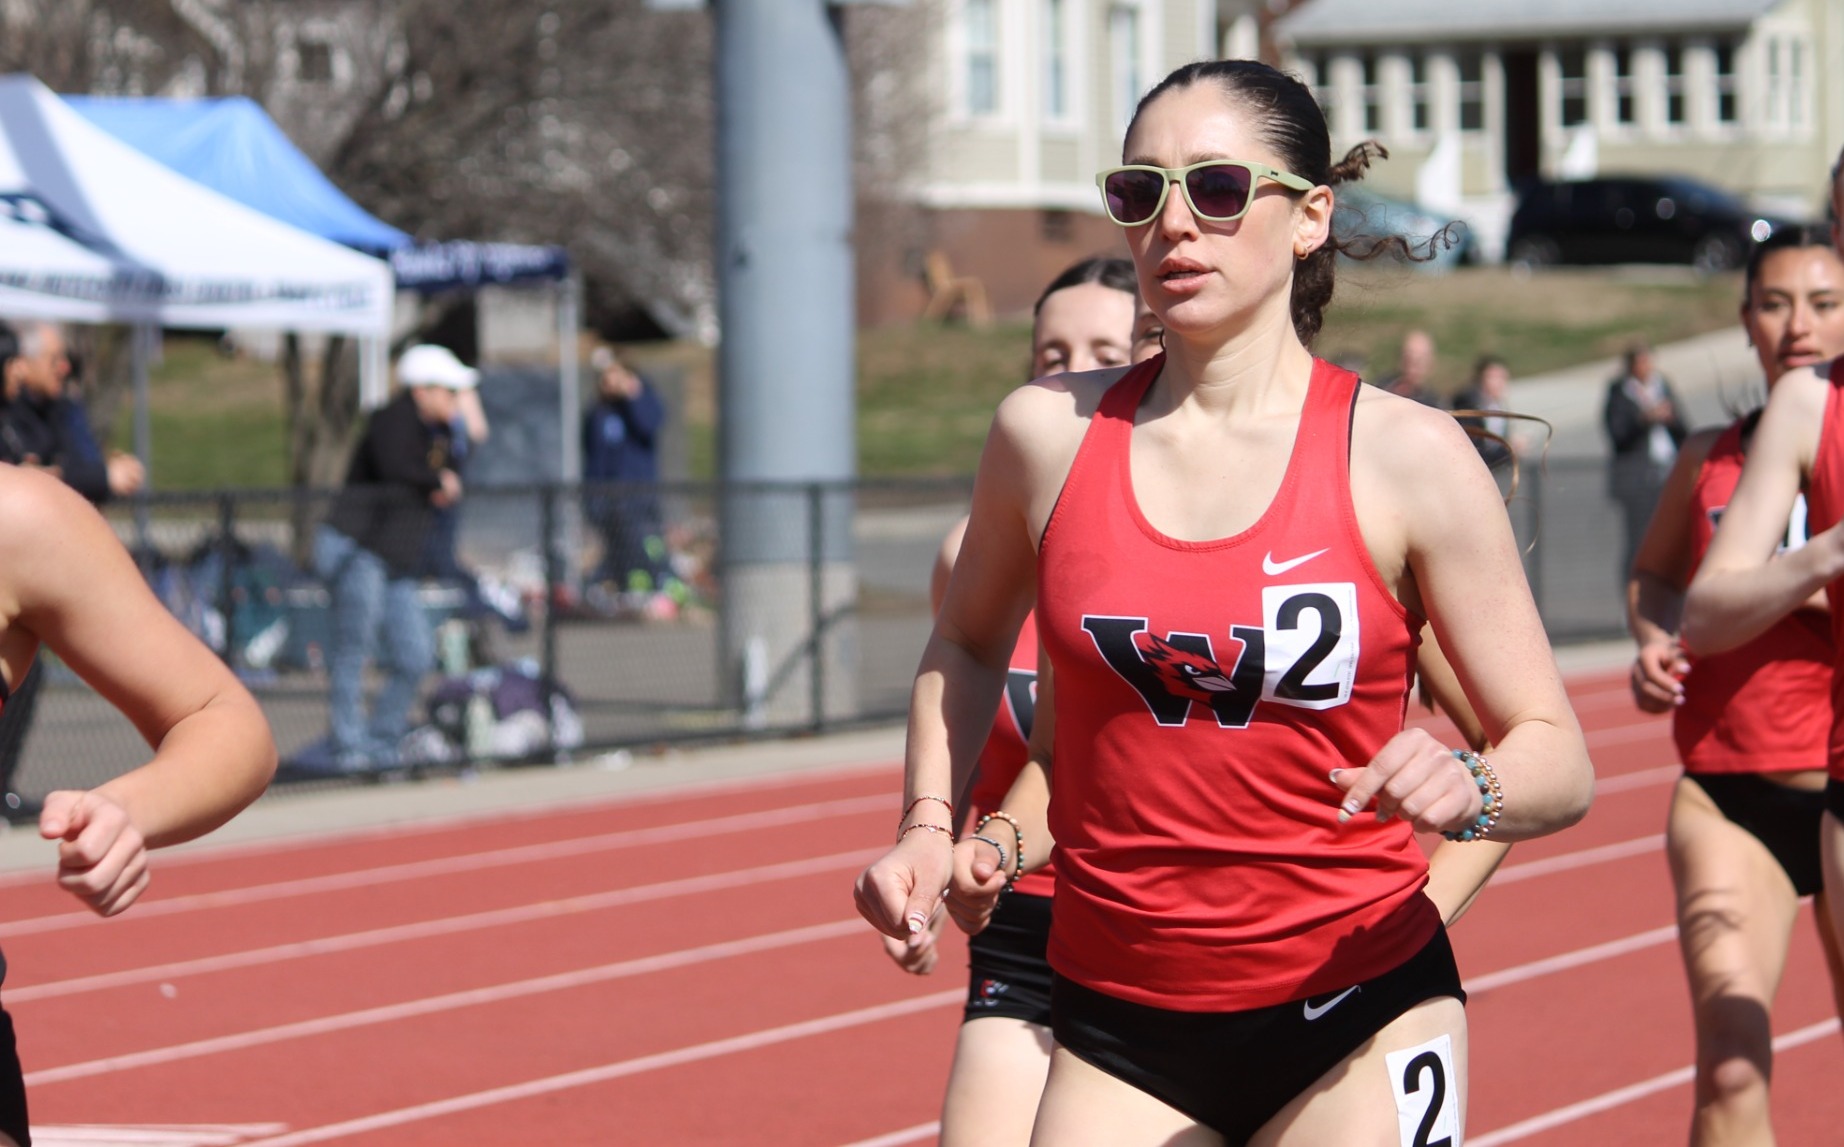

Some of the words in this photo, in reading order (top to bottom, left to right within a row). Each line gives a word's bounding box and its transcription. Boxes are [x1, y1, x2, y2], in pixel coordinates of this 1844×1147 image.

[1081, 614, 1265, 729] W
[1274, 592, 1343, 702] 2
[1403, 1050, 1451, 1147] 2
